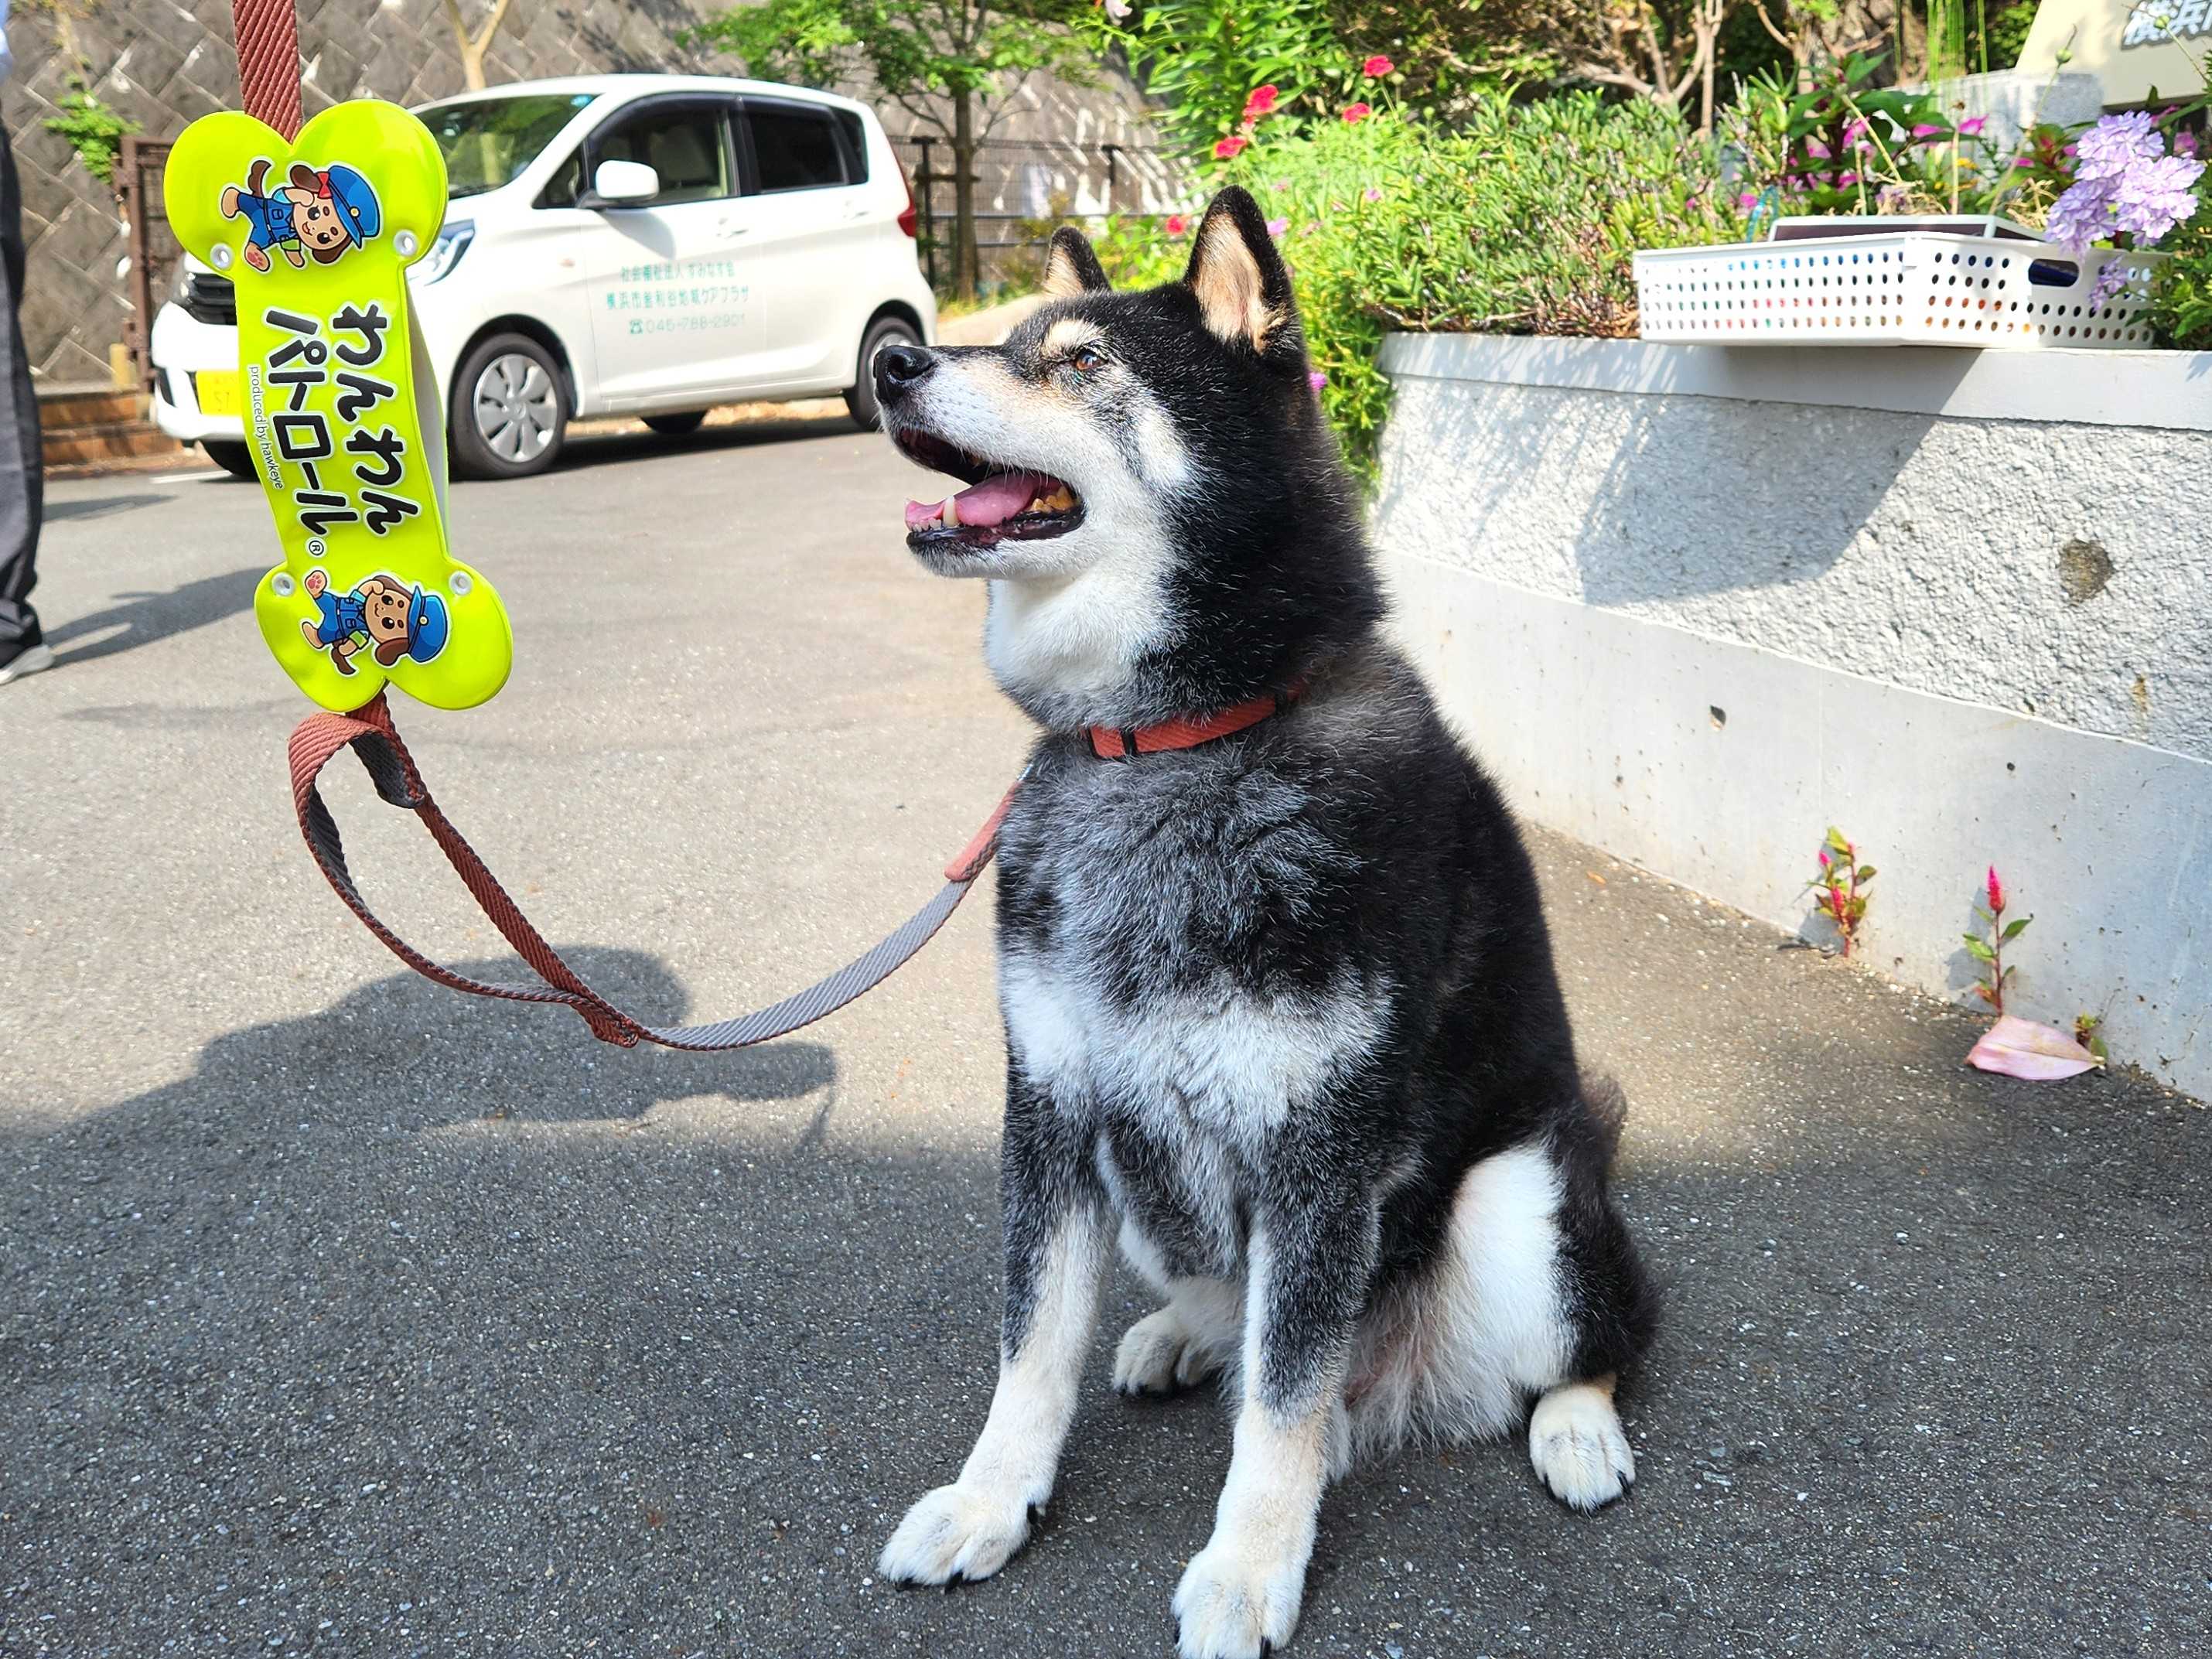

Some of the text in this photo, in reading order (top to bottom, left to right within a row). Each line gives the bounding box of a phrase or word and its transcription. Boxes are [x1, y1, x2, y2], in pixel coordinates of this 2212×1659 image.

[2123, 0, 2212, 46] 横浜
[248, 366, 284, 490] produced by hawkeye
[331, 303, 419, 535] わんわん
